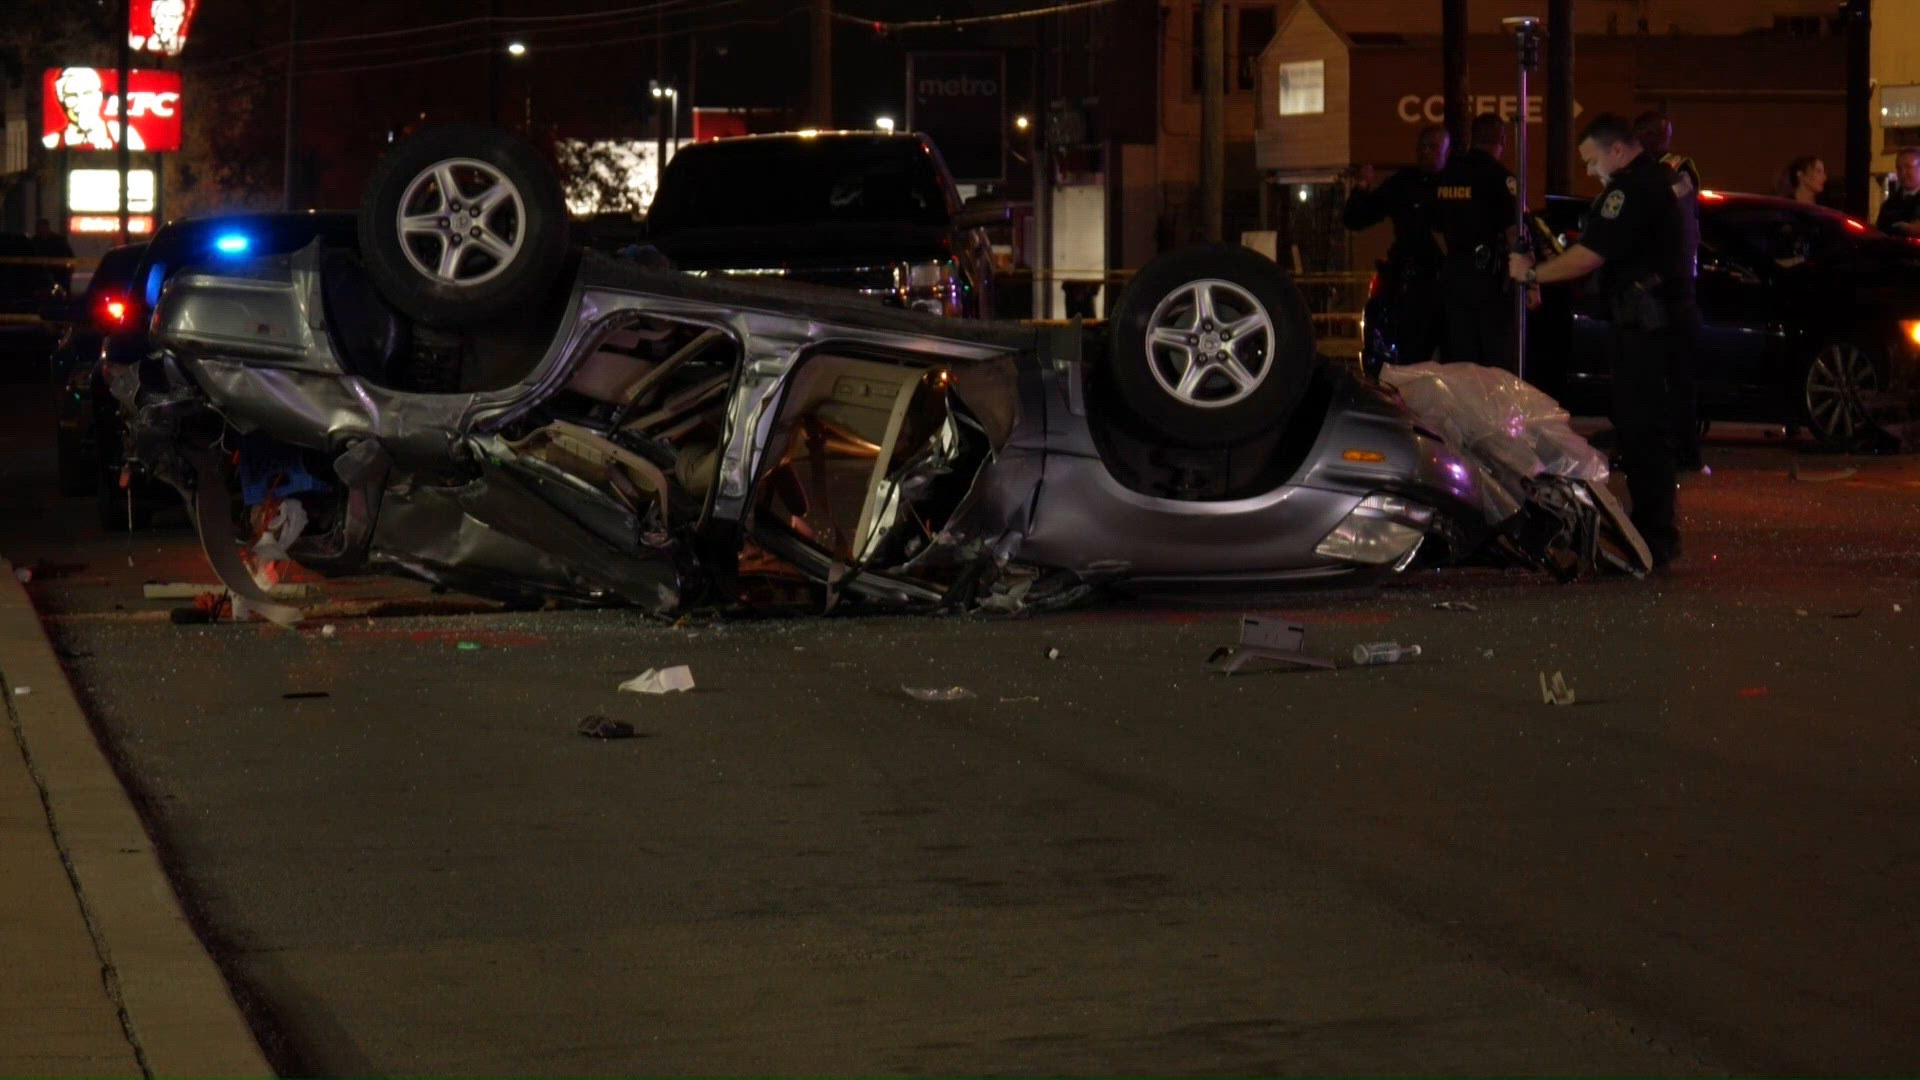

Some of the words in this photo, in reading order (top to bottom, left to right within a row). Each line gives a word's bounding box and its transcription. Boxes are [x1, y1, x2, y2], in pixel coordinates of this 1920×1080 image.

[918, 75, 998, 97] metro
[1397, 95, 1543, 123] COFEE
[1436, 185, 1473, 199] POLICE
